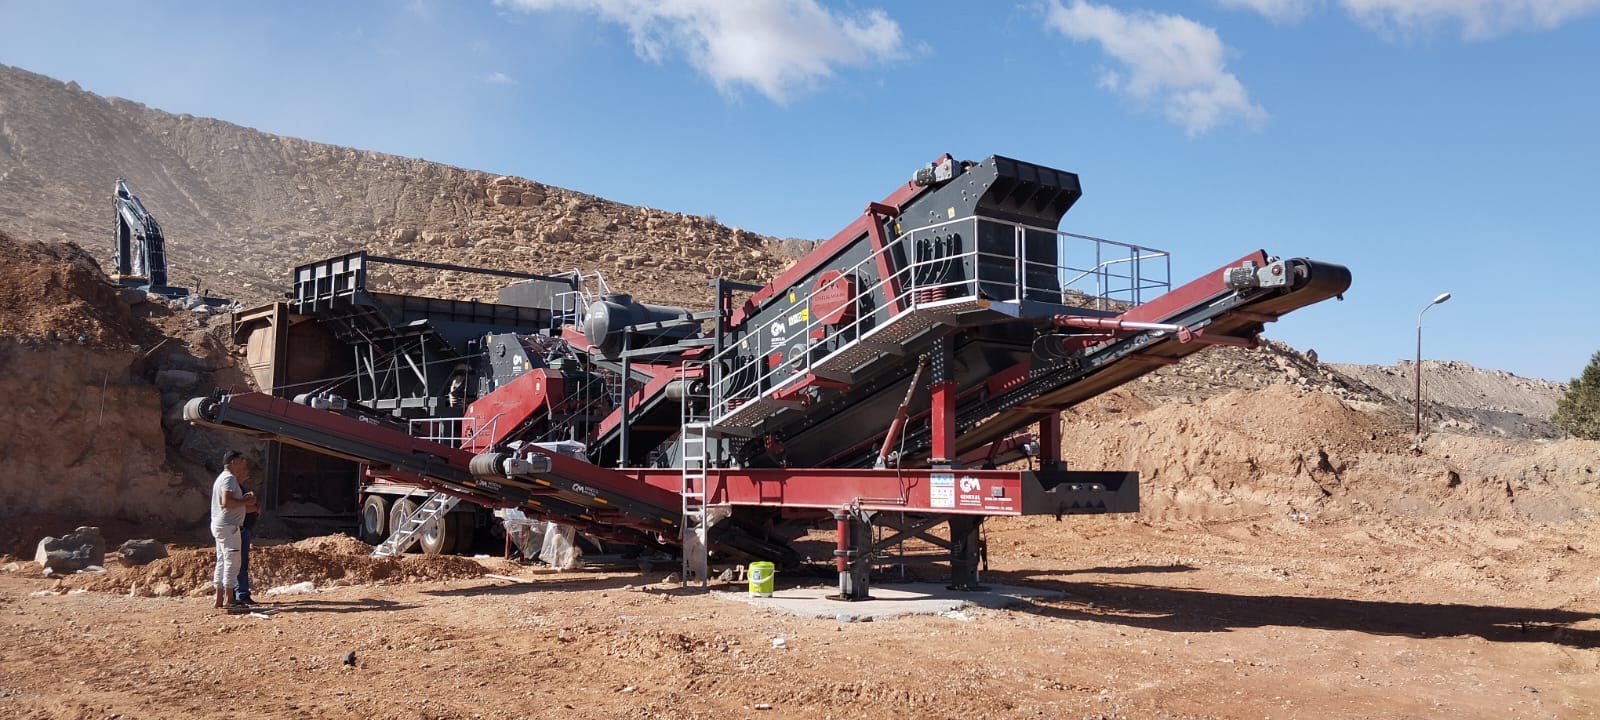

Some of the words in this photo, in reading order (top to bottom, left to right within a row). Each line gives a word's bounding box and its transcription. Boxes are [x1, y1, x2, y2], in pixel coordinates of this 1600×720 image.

[771, 322, 786, 337] GM
[572, 483, 584, 494] GM
[960, 475, 981, 492] GM
